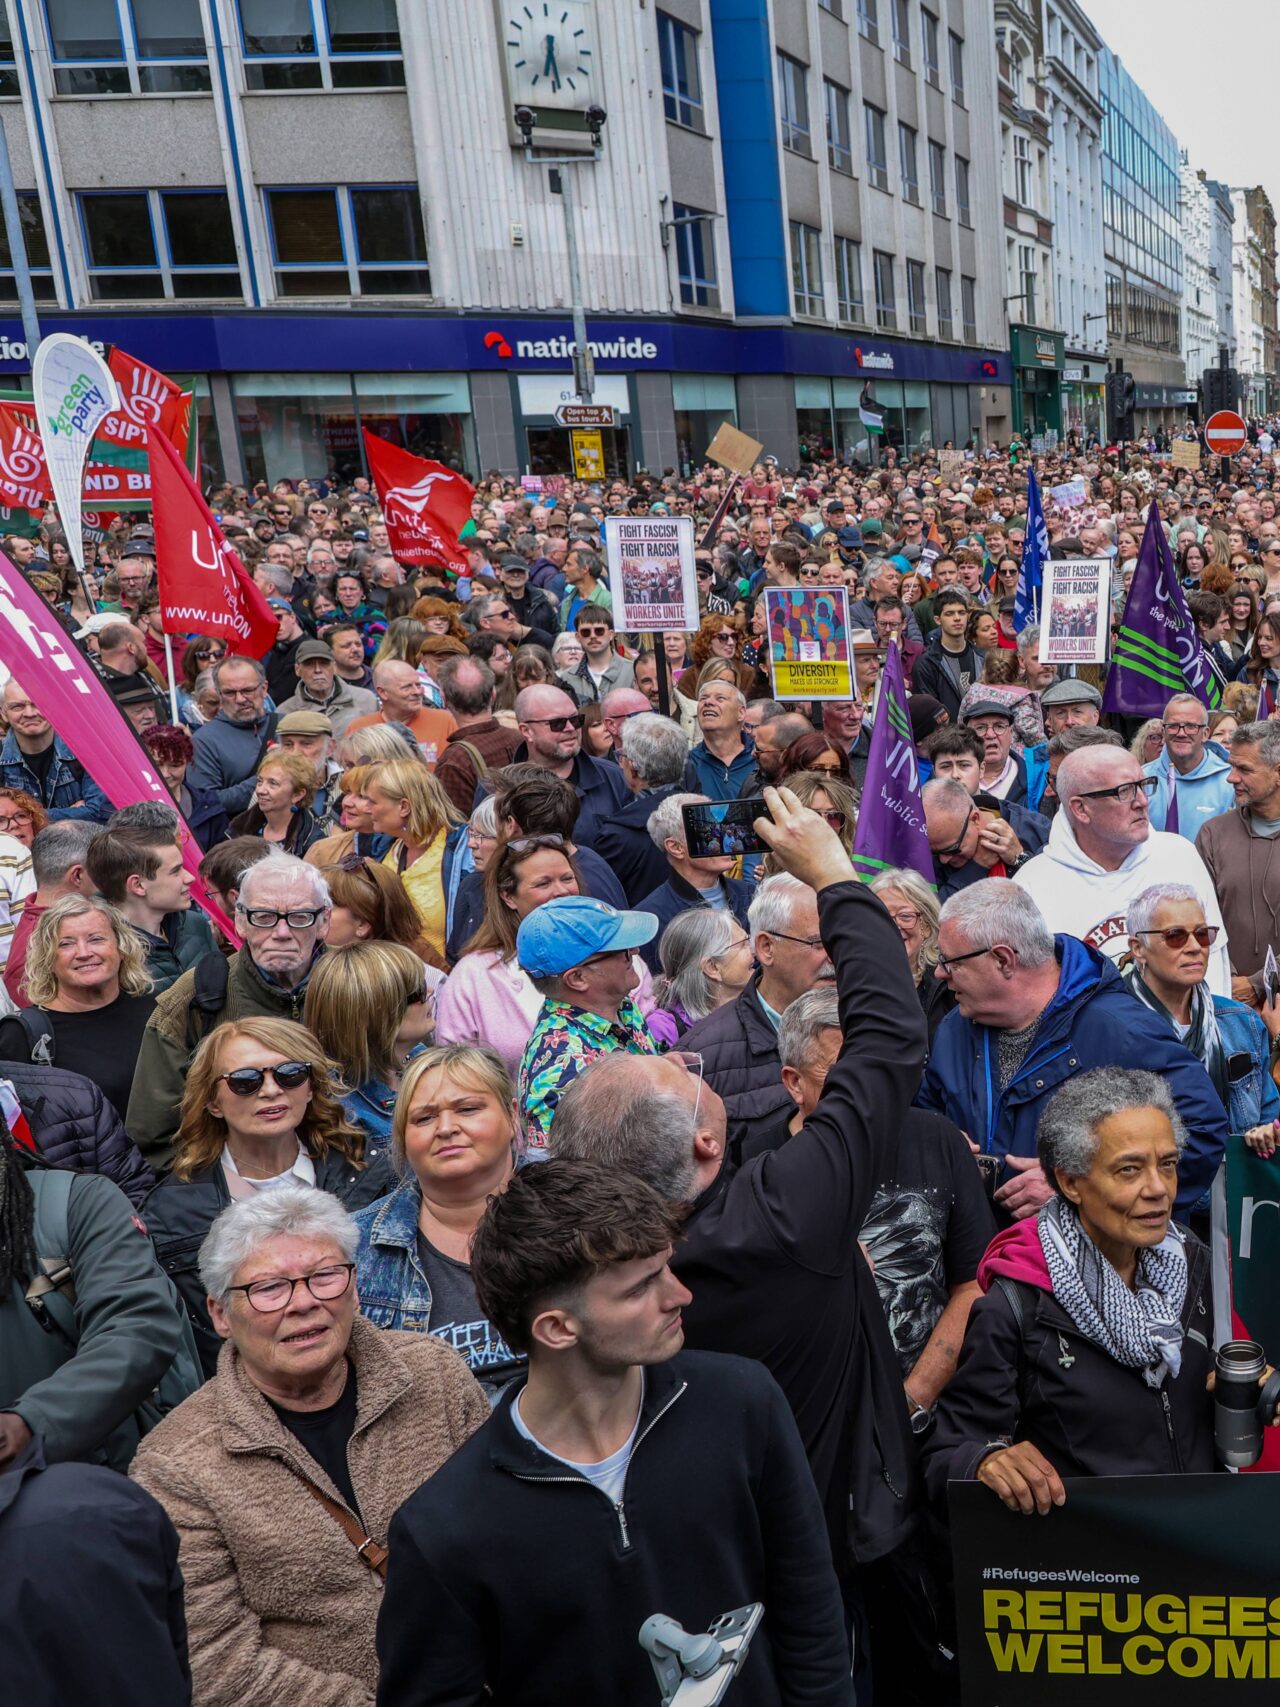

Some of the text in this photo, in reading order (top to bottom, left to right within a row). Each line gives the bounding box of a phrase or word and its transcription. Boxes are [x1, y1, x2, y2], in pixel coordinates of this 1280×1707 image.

[56, 372, 94, 437] green
[70, 384, 107, 434] party
[567, 408, 599, 417] Open top
[105, 416, 148, 446] SIPT
[619, 524, 678, 538] FIGHT FASCISM
[620, 543, 680, 557] FIGHT RACISM
[1053, 565, 1099, 578] FIGHT FASCISM
[1052, 581, 1099, 594] FIGHT RACISM
[625, 605, 685, 619] WORKERS UNITE
[1150, 606, 1165, 622] the
[1049, 639, 1096, 651] WORKERS UNITE
[789, 665, 836, 677] DIVERSITY
[982, 1568, 1140, 1584] #RefugeesWelcome
